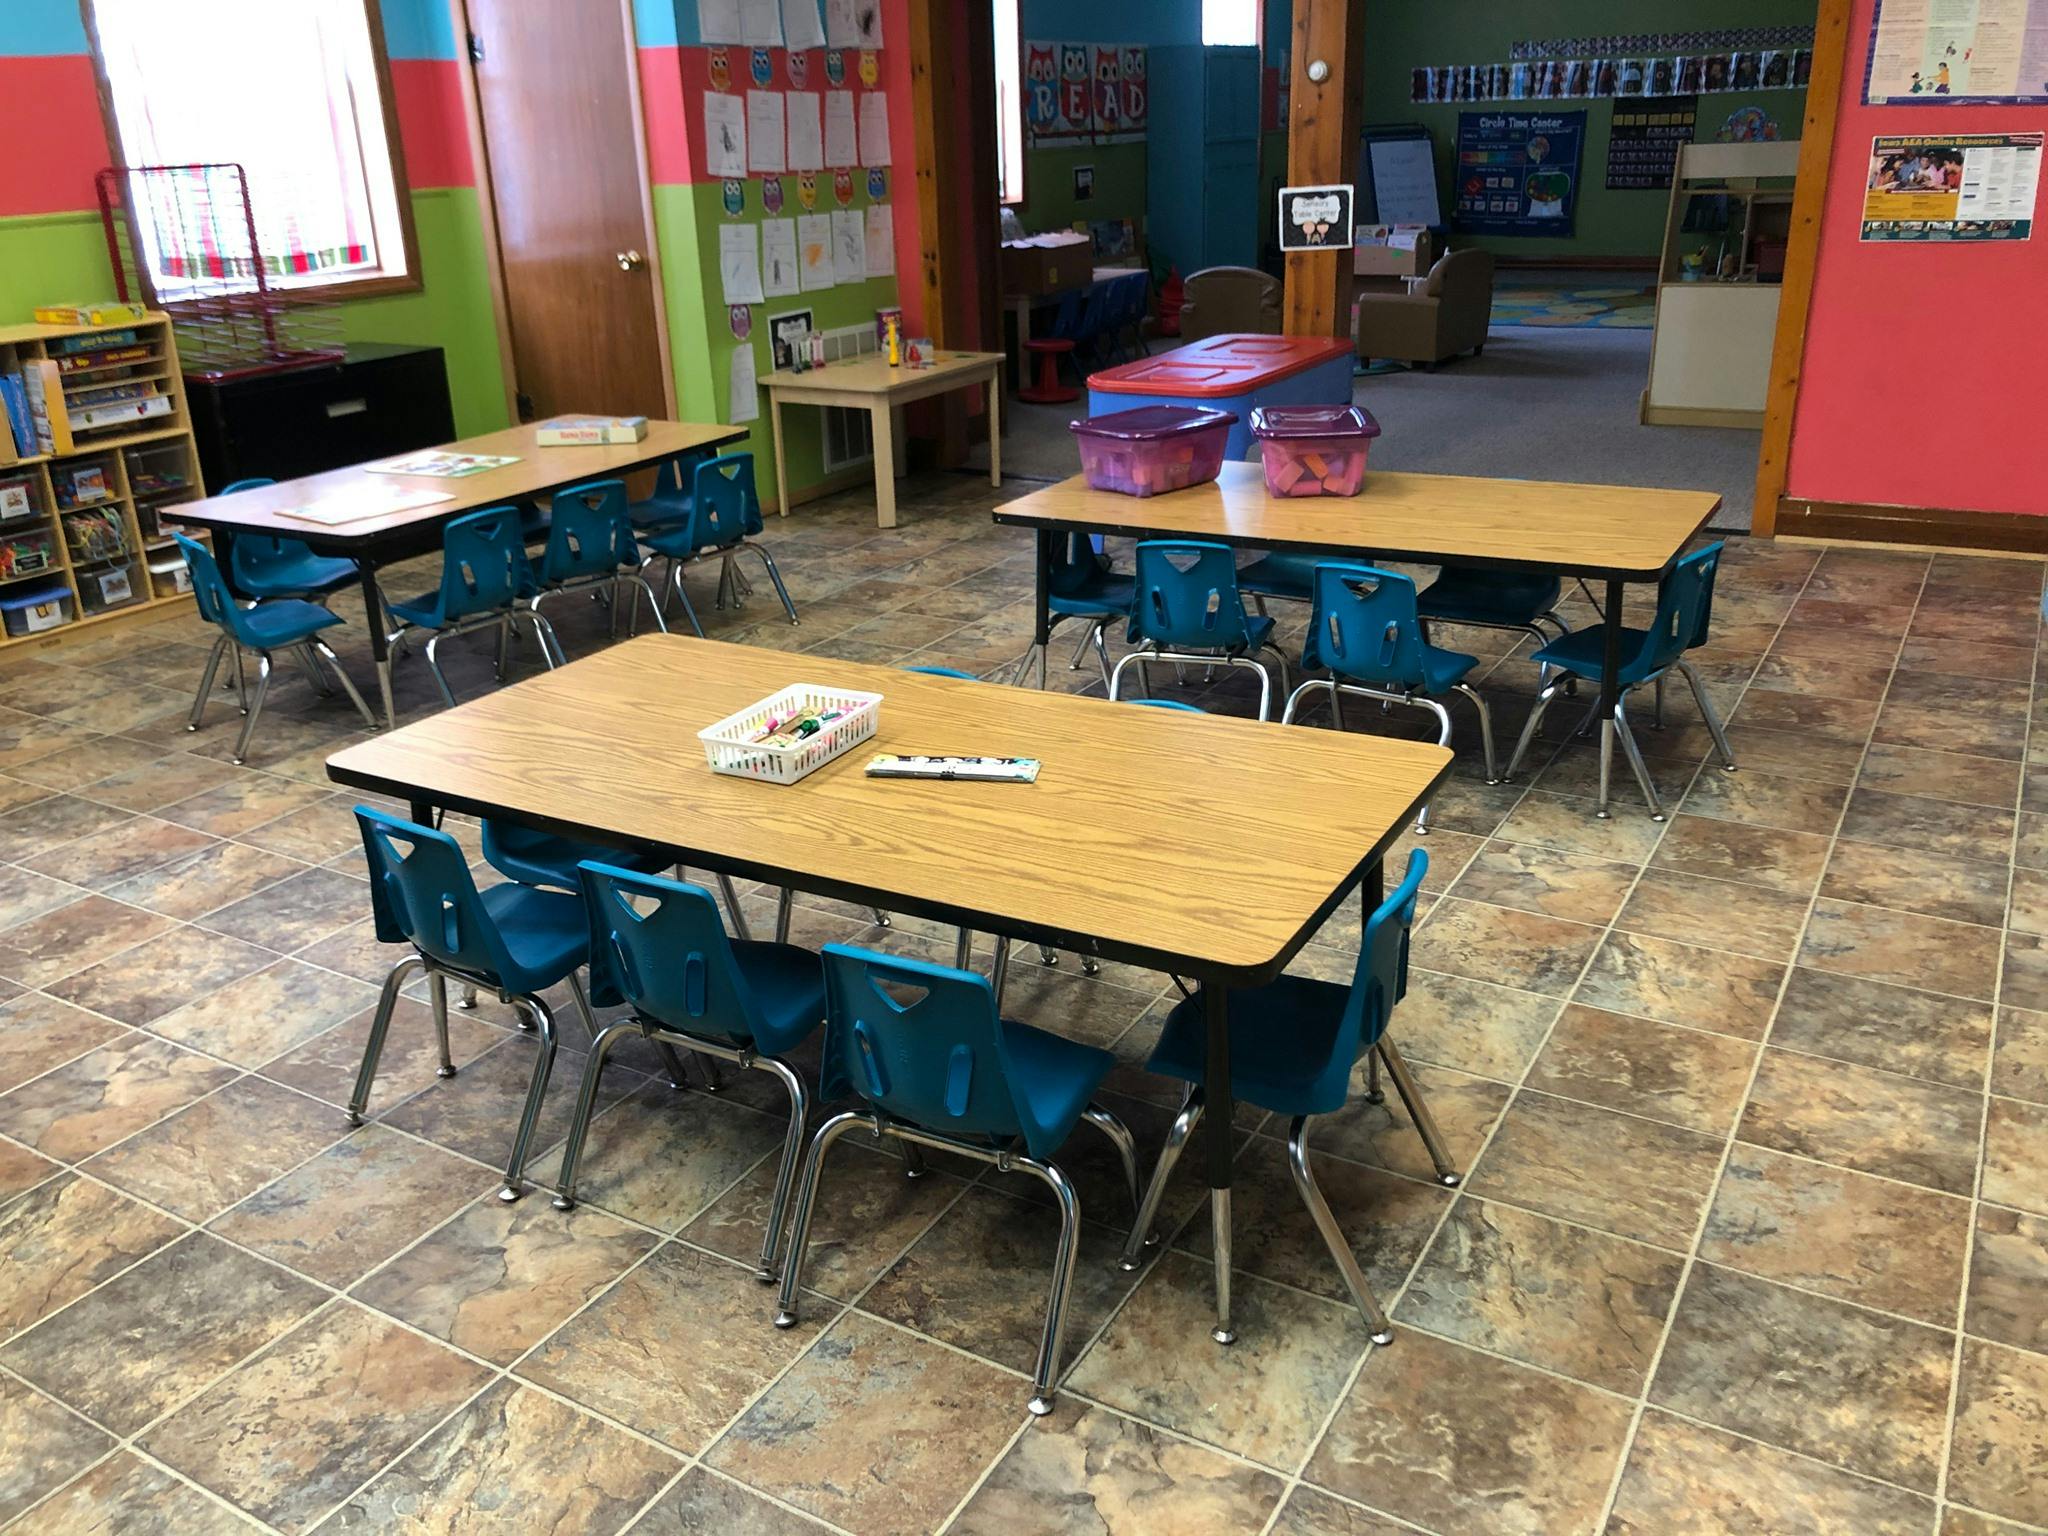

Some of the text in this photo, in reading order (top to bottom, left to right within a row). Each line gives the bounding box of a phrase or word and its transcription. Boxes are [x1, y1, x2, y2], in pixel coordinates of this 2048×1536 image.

[1034, 84, 1145, 122] READ
[1479, 115, 1563, 128] Circle Time Center
[1923, 137, 1954, 147] Online
[1955, 136, 2004, 146] Resources
